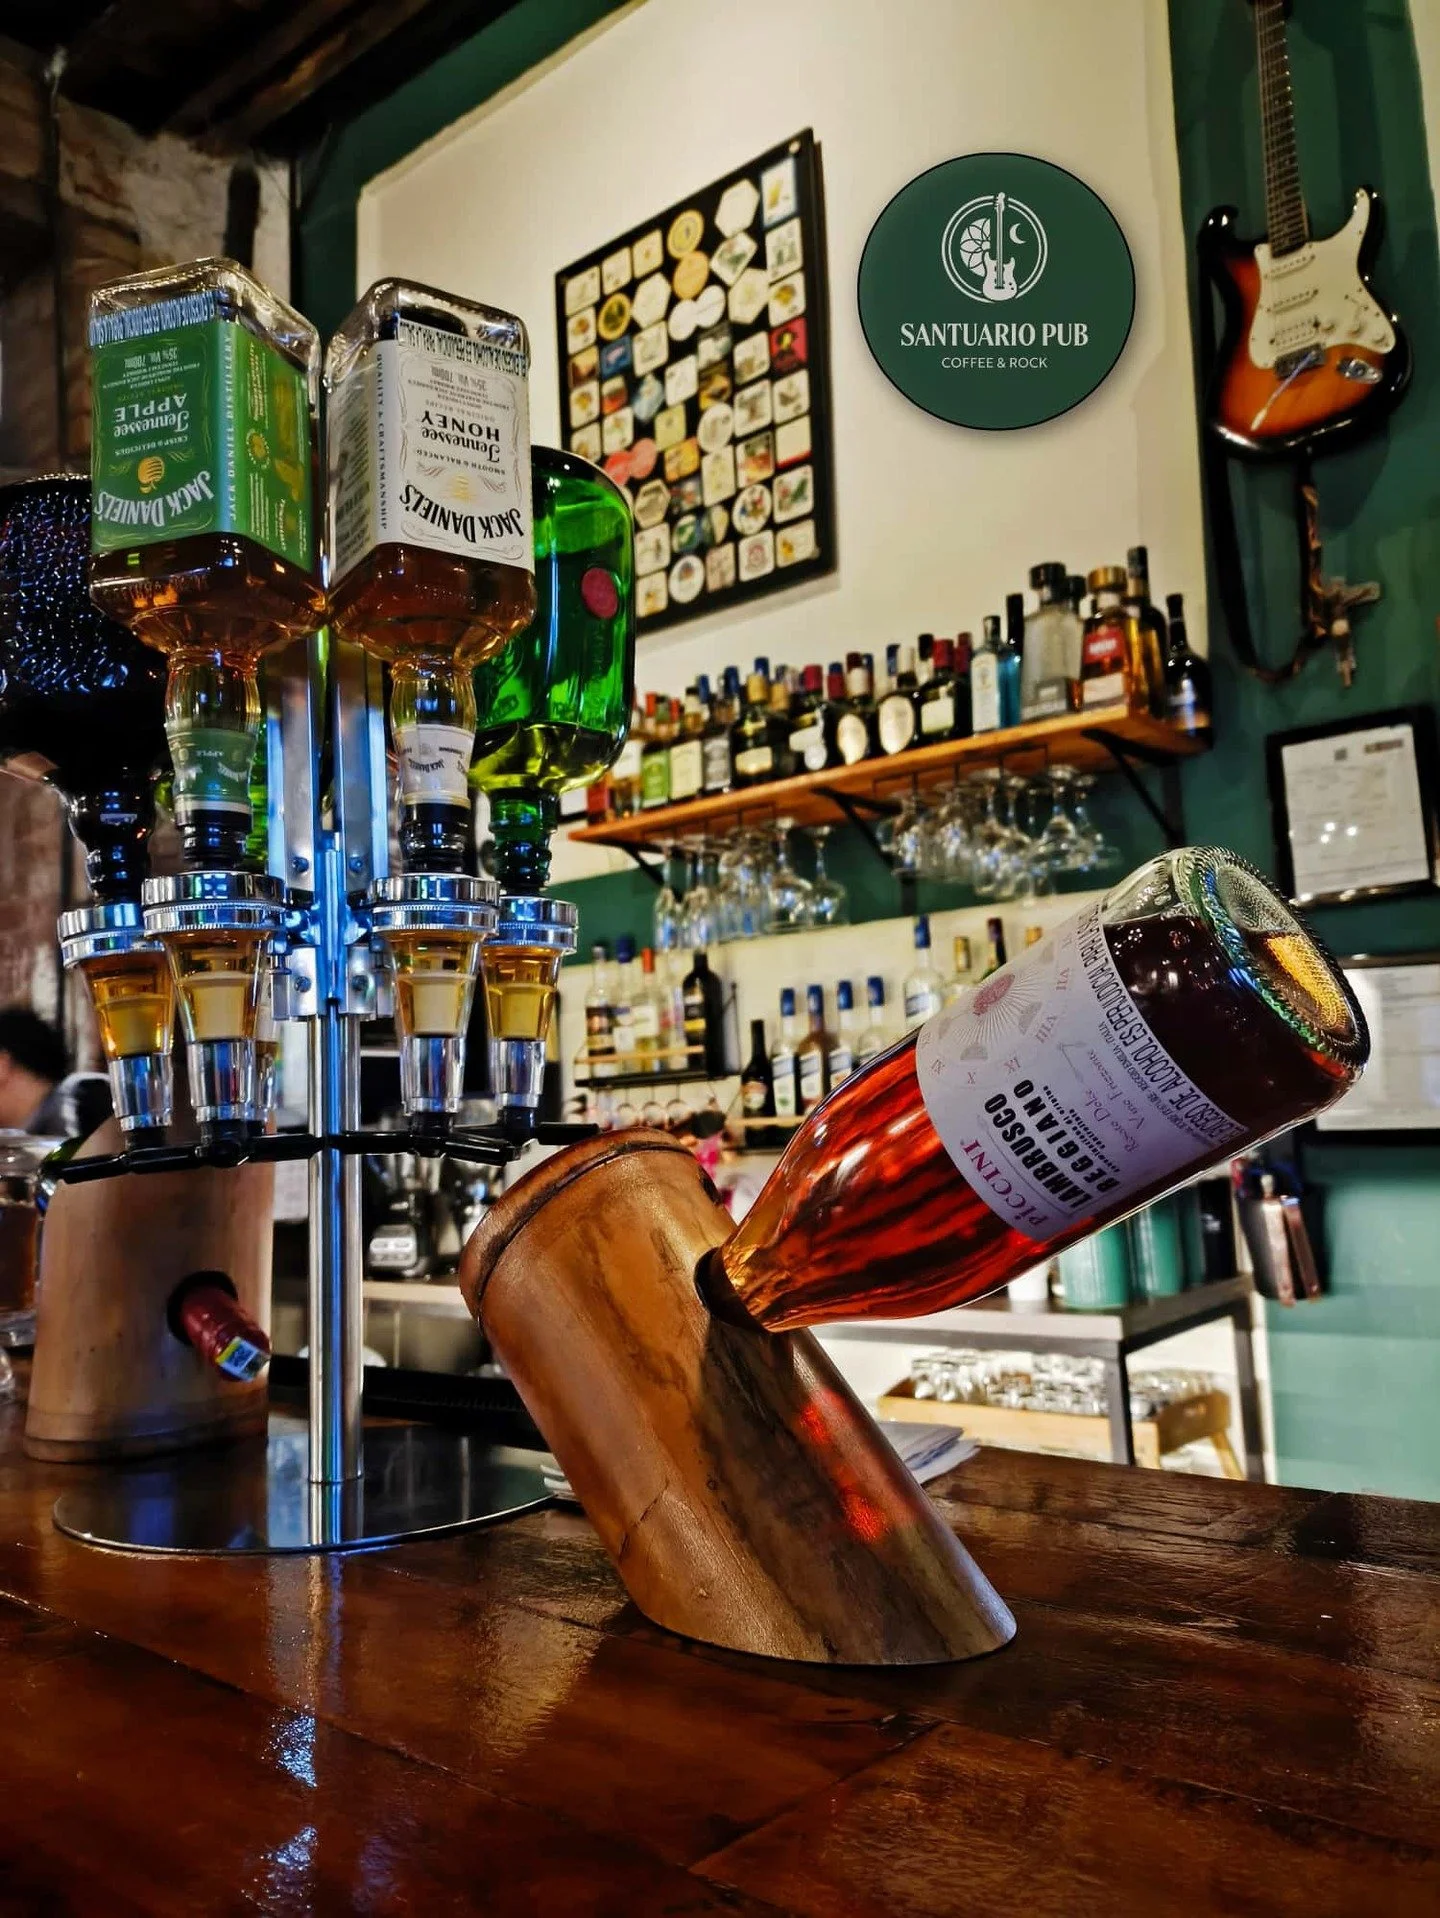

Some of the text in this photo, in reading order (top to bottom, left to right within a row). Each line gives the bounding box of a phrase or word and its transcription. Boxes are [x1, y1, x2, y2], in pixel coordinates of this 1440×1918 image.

[900, 323, 1088, 346] SANTUARIO PUB
[942, 357, 1048, 368] COFFEE & ROCK
[114, 411, 189, 437] Tennessee
[115, 393, 187, 422] APPLE
[164, 436, 188, 445] CRISP
[224, 335, 237, 520] JACK DANIEL DISTILLERY
[422, 410, 499, 442] HONEY
[114, 441, 156, 456] DELICIOUS
[417, 449, 461, 465] BALANCED
[422, 427, 500, 463] Tennessee
[378, 423, 387, 530] CRAFTSMANSHIP
[471, 461, 505, 475] SMOOTH
[94, 491, 165, 527] DANIEL'S
[165, 470, 214, 517] JACK
[399, 484, 524, 543] JACK DANIEL'S
[1080, 933, 1107, 969] PARA
[1087, 958, 1138, 1033] PERJUDICIAL
[1118, 1020, 1148, 1048] ES
[1131, 1036, 1187, 1092] ALCOHOL
[1087, 1048, 1144, 1130] Vino Frizzante
[1168, 1087, 1201, 1112] DE
[985, 1092, 1093, 1211] LAMBRUSCO
[1014, 1079, 1120, 1194] REGGIANO
